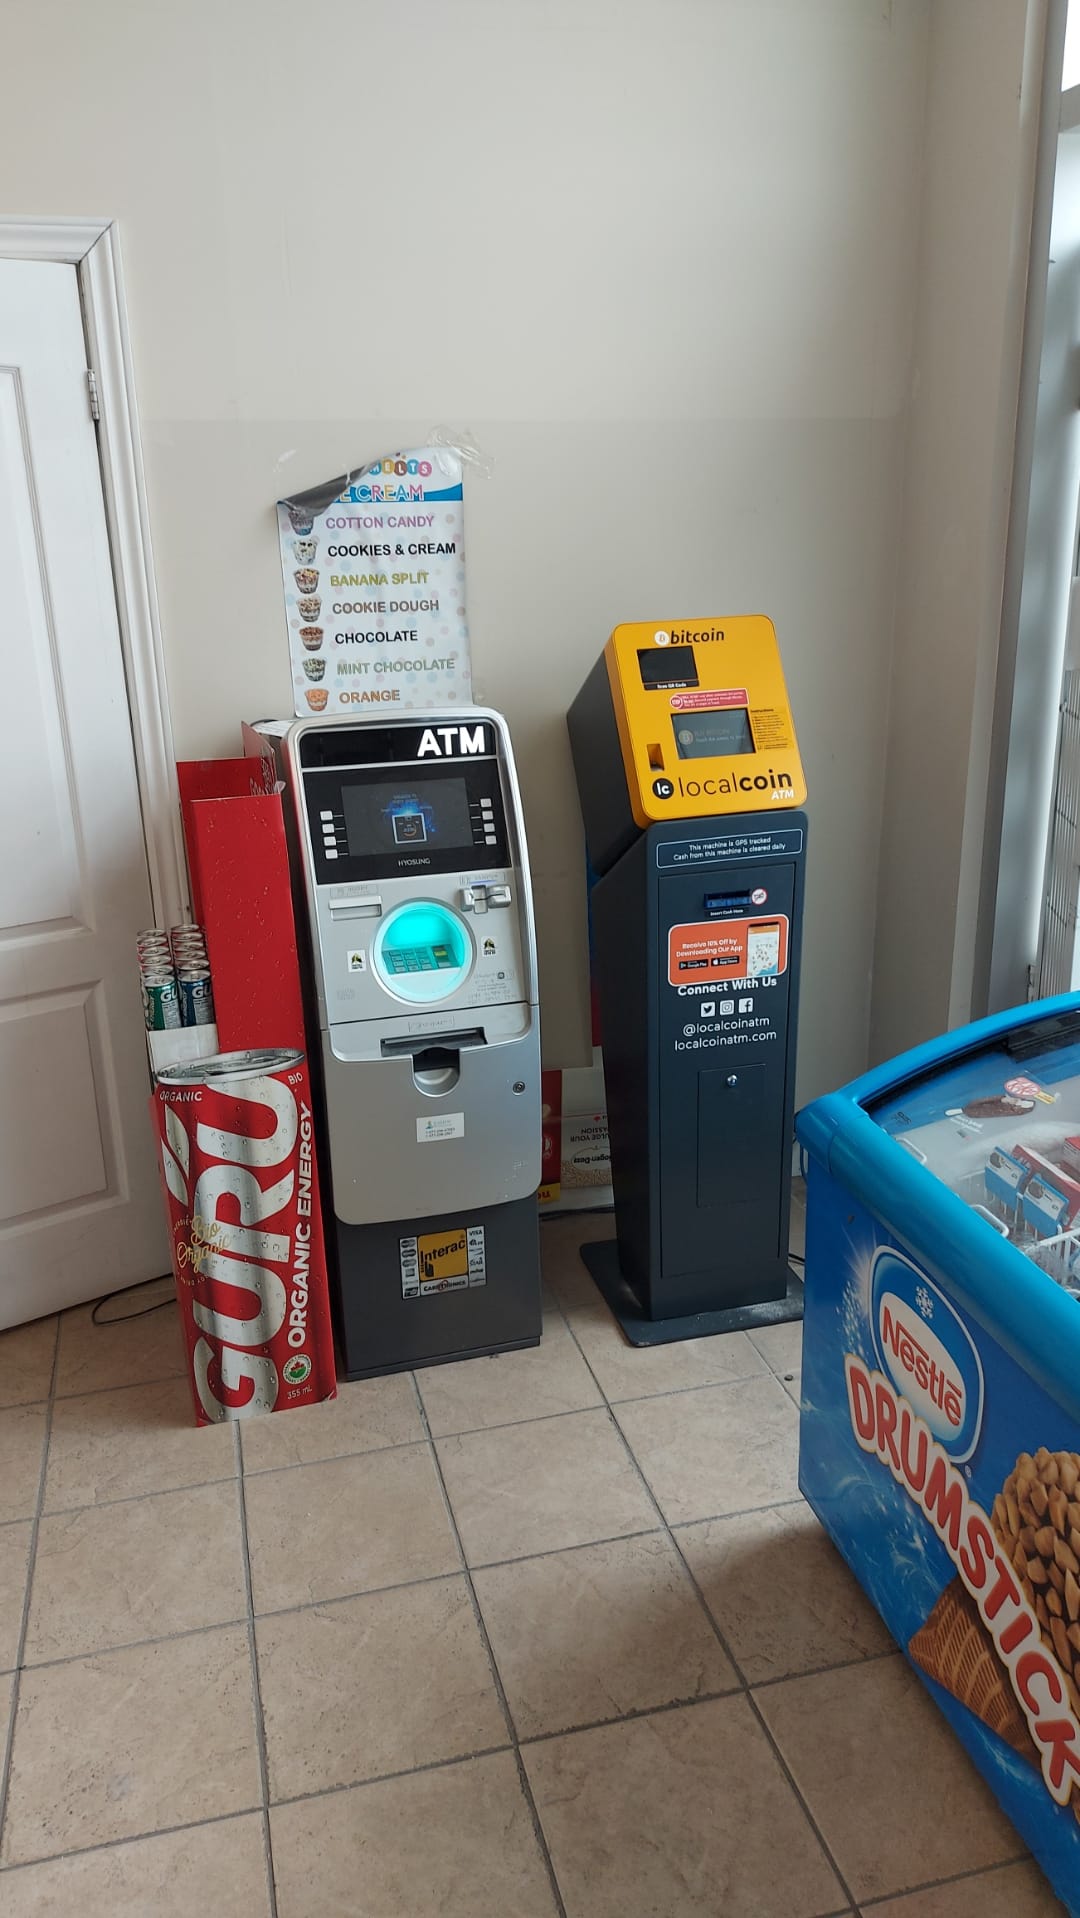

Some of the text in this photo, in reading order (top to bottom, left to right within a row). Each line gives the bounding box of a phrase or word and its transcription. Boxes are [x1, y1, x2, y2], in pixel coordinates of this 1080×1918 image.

[356, 484, 423, 501] CREAM
[325, 515, 434, 529] COTTON CANDY
[327, 543, 456, 557] COOKIES & CREAM
[330, 572, 429, 587] BANANA SPLIT
[332, 600, 439, 614] COOKIE DOUGH
[334, 630, 418, 644] CHOCOLATE
[671, 628, 724, 644] bitcoin
[336, 658, 456, 675] MINT CHOCOLATE
[339, 690, 401, 704] ORANGE
[417, 725, 486, 758] ATM
[678, 769, 792, 798] localcoin
[771, 789, 794, 800] ATM
[703, 842, 727, 850] machine
[749, 837, 771, 845] tracked
[717, 848, 741, 856] machine
[749, 844, 771, 852] cleared
[398, 858, 431, 867] HYOSUNG
[677, 977, 777, 996] Connect With Us
[683, 1017, 770, 1036] @localcoinatm
[675, 1031, 777, 1051] localcoinatm.com
[288, 1072, 304, 1085] BIO
[160, 1091, 203, 1102] ORGANIC
[581, 1127, 608, 1135] ASSION
[296, 1101, 313, 1217] ENERGY
[420, 1239, 466, 1264] Interac
[287, 1222, 312, 1349] ORGANIC
[287, 1388, 301, 1400] 355
[848, 1362, 1080, 1790] DRUMSTICK
